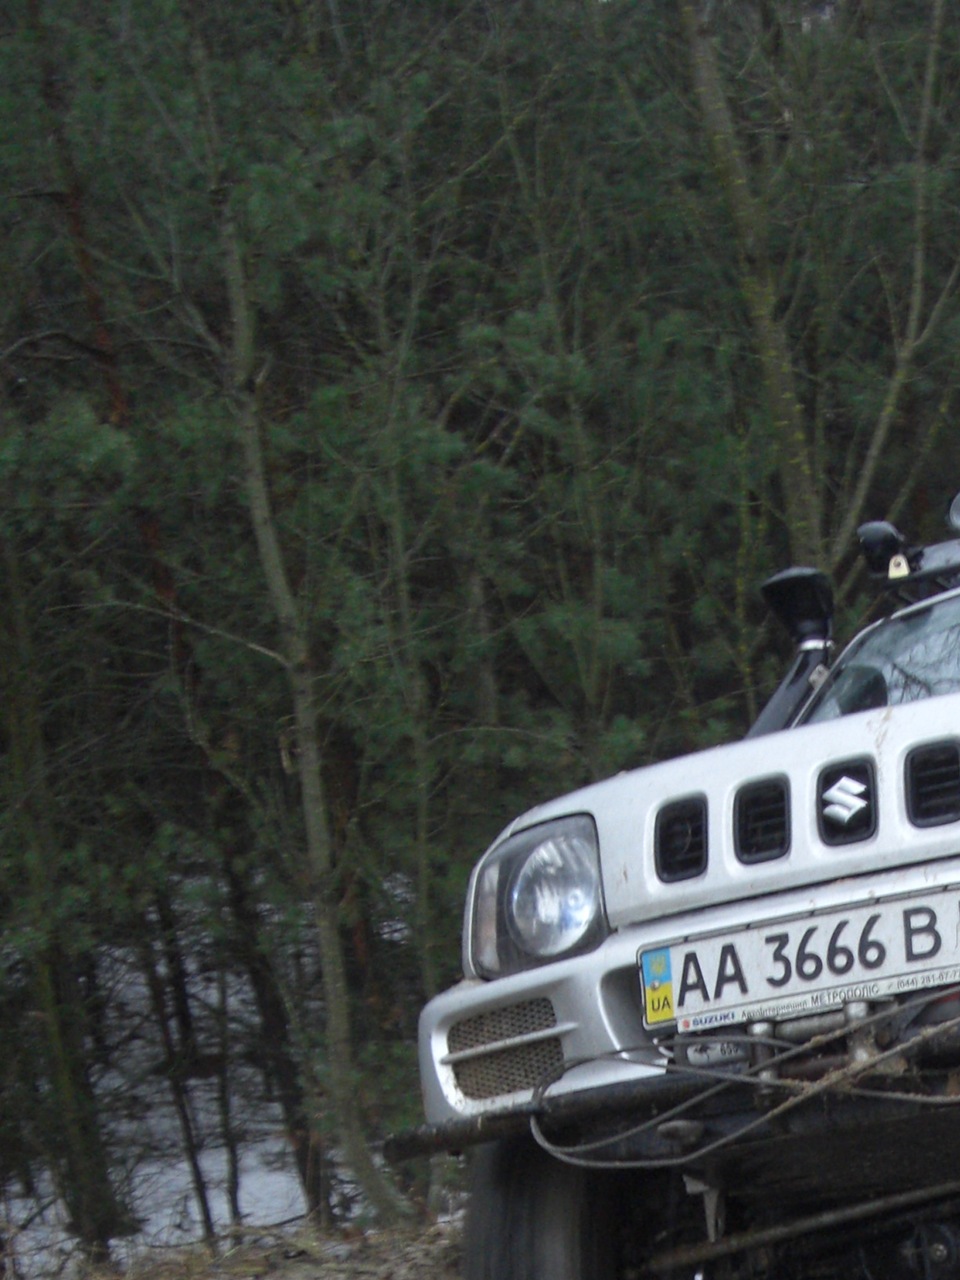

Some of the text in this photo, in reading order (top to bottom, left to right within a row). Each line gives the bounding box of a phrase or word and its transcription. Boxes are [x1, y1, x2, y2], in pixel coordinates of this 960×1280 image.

[677, 942, 748, 1008] AA
[765, 914, 886, 988] 3666
[651, 997, 671, 1013] UA
[692, 1011, 736, 1027] SUZUKI
